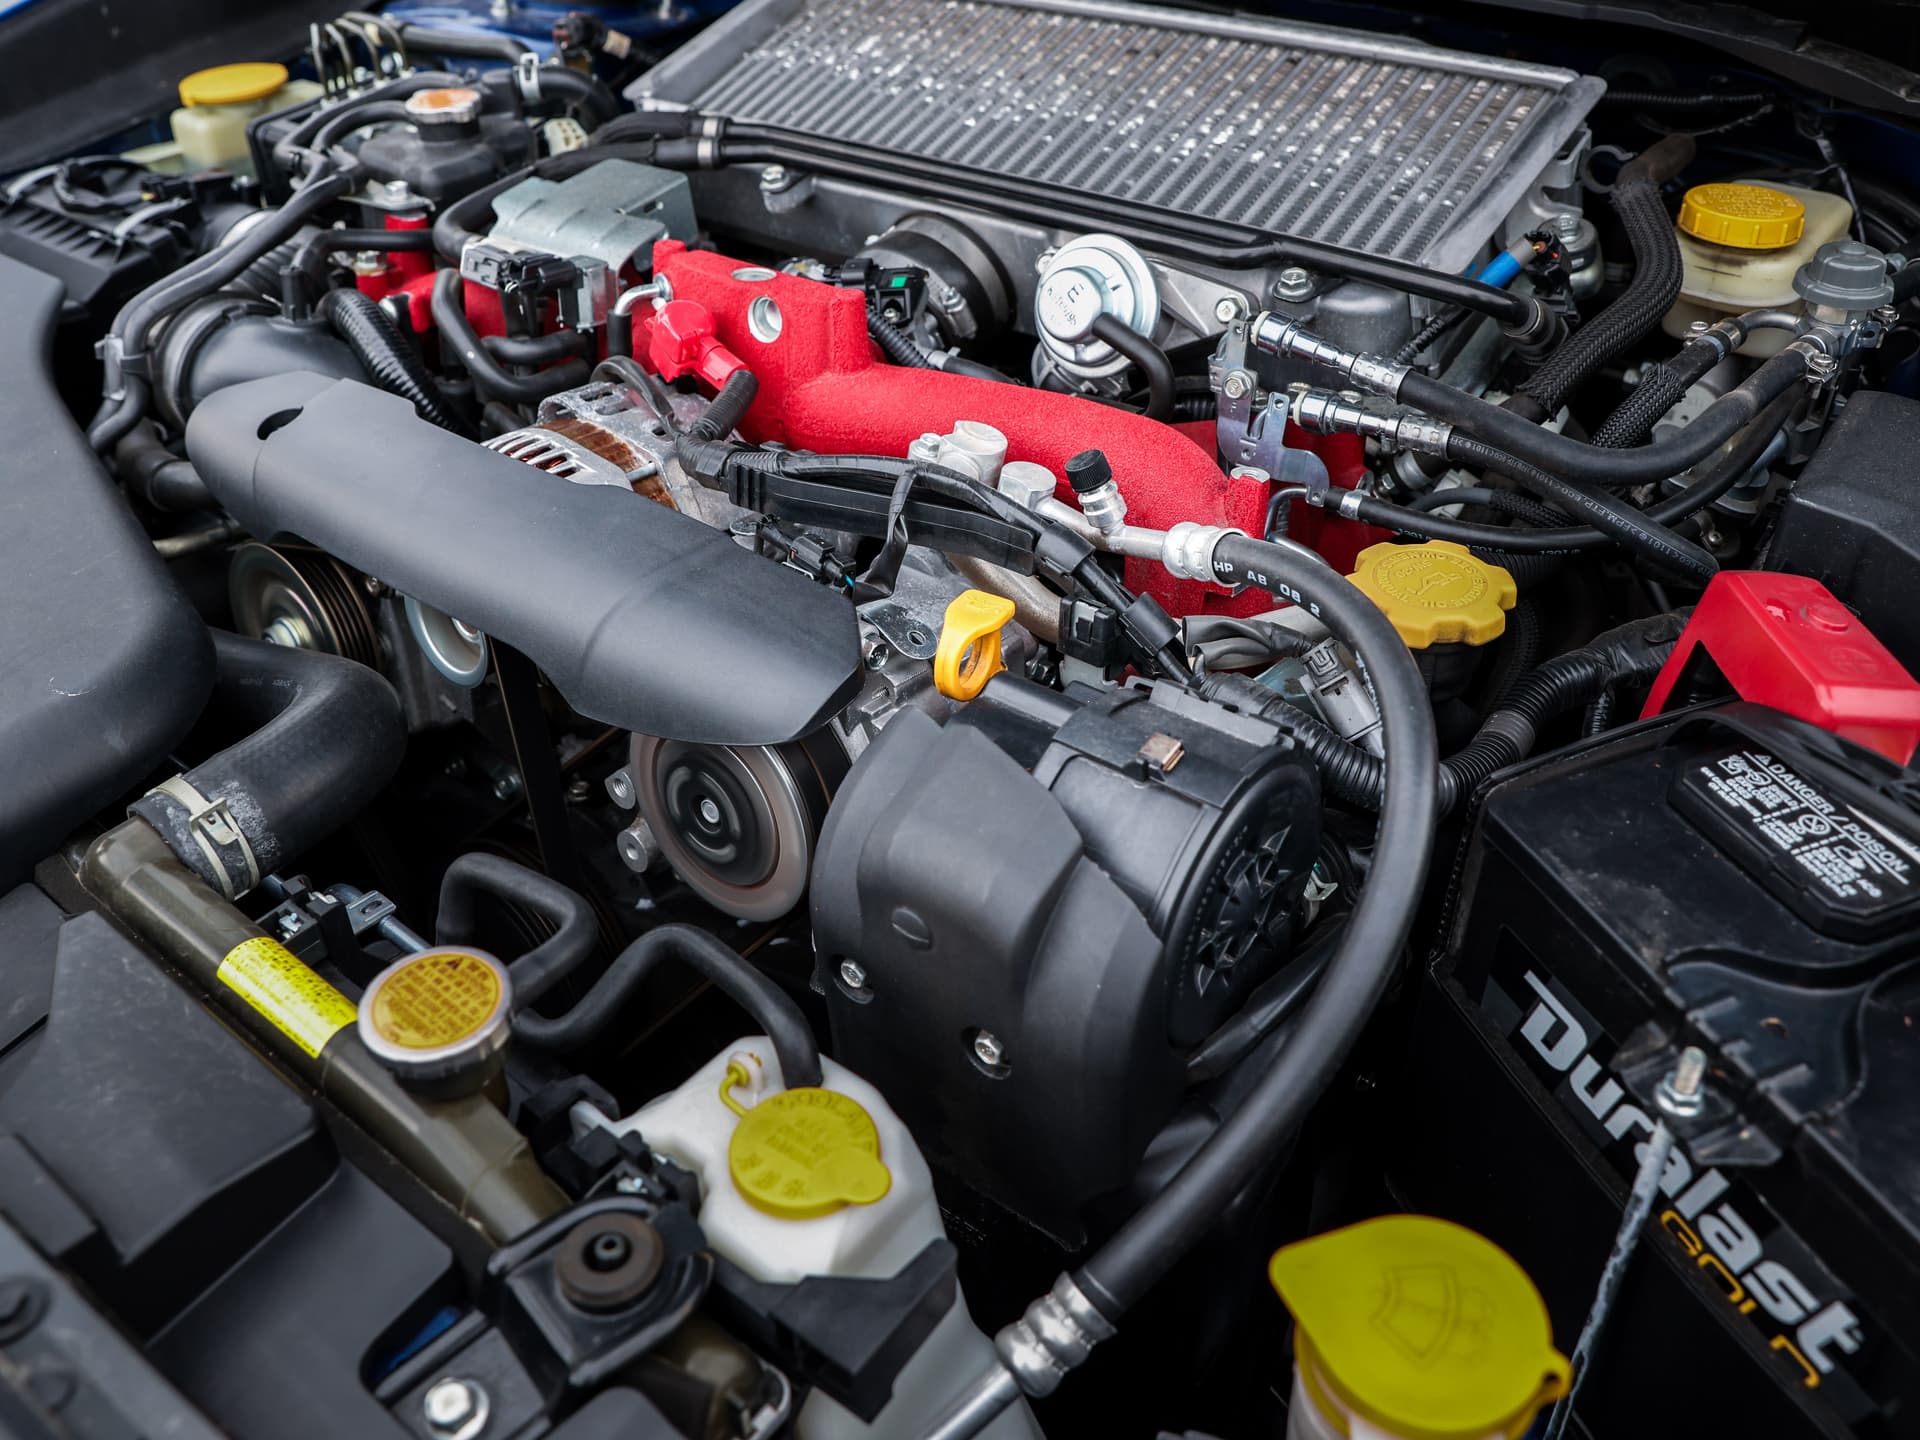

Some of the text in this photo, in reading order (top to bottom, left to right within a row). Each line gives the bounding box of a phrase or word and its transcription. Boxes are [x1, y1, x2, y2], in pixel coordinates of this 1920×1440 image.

[1213, 561, 1233, 573] HP
[1421, 600, 1448, 609] OIL
[1768, 763, 1837, 815] DANGER
[1842, 823, 1911, 873] POISON
